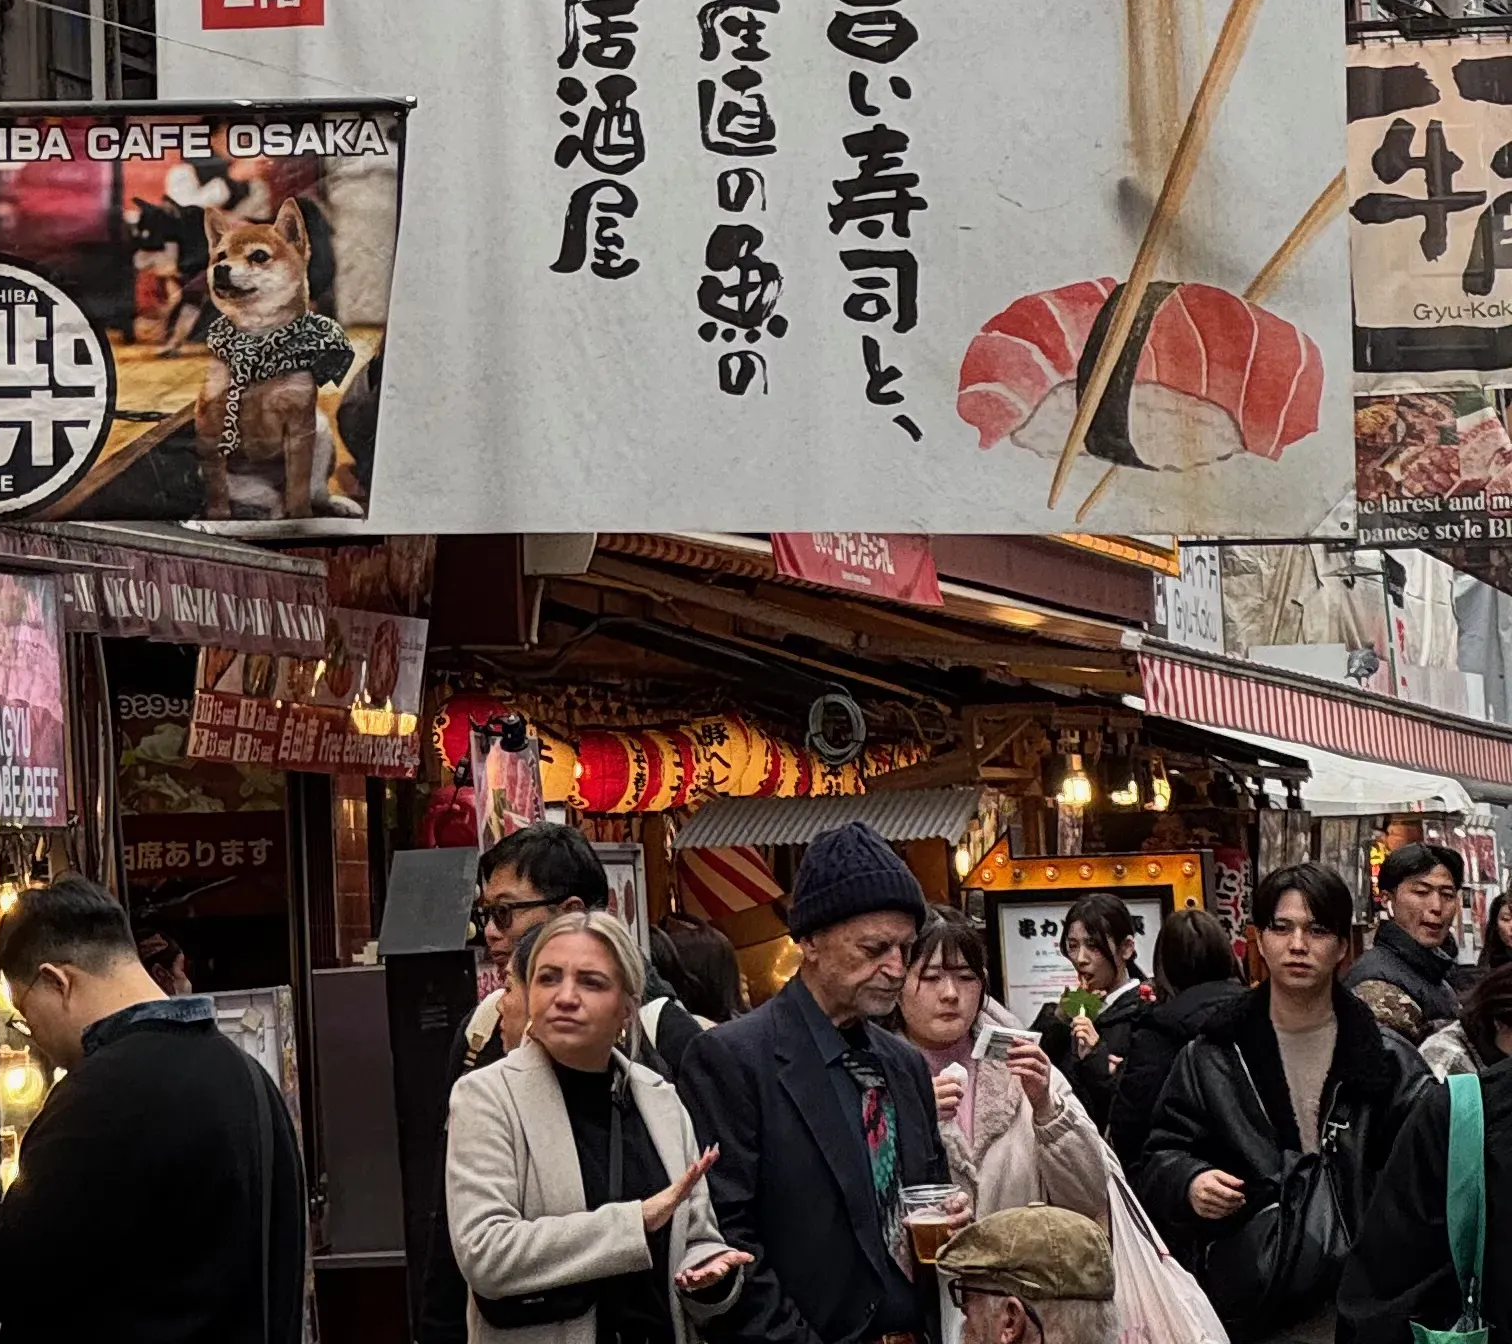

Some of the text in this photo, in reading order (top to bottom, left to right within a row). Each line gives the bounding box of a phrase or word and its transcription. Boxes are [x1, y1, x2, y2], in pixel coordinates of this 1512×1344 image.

[88, 125, 213, 161] CAFE
[226, 120, 389, 158] OSAKA
[1382, 492, 1440, 513] larest
[1449, 493, 1486, 512] and
[1435, 518, 1483, 543] style
[23, 766, 59, 818] BEEF
